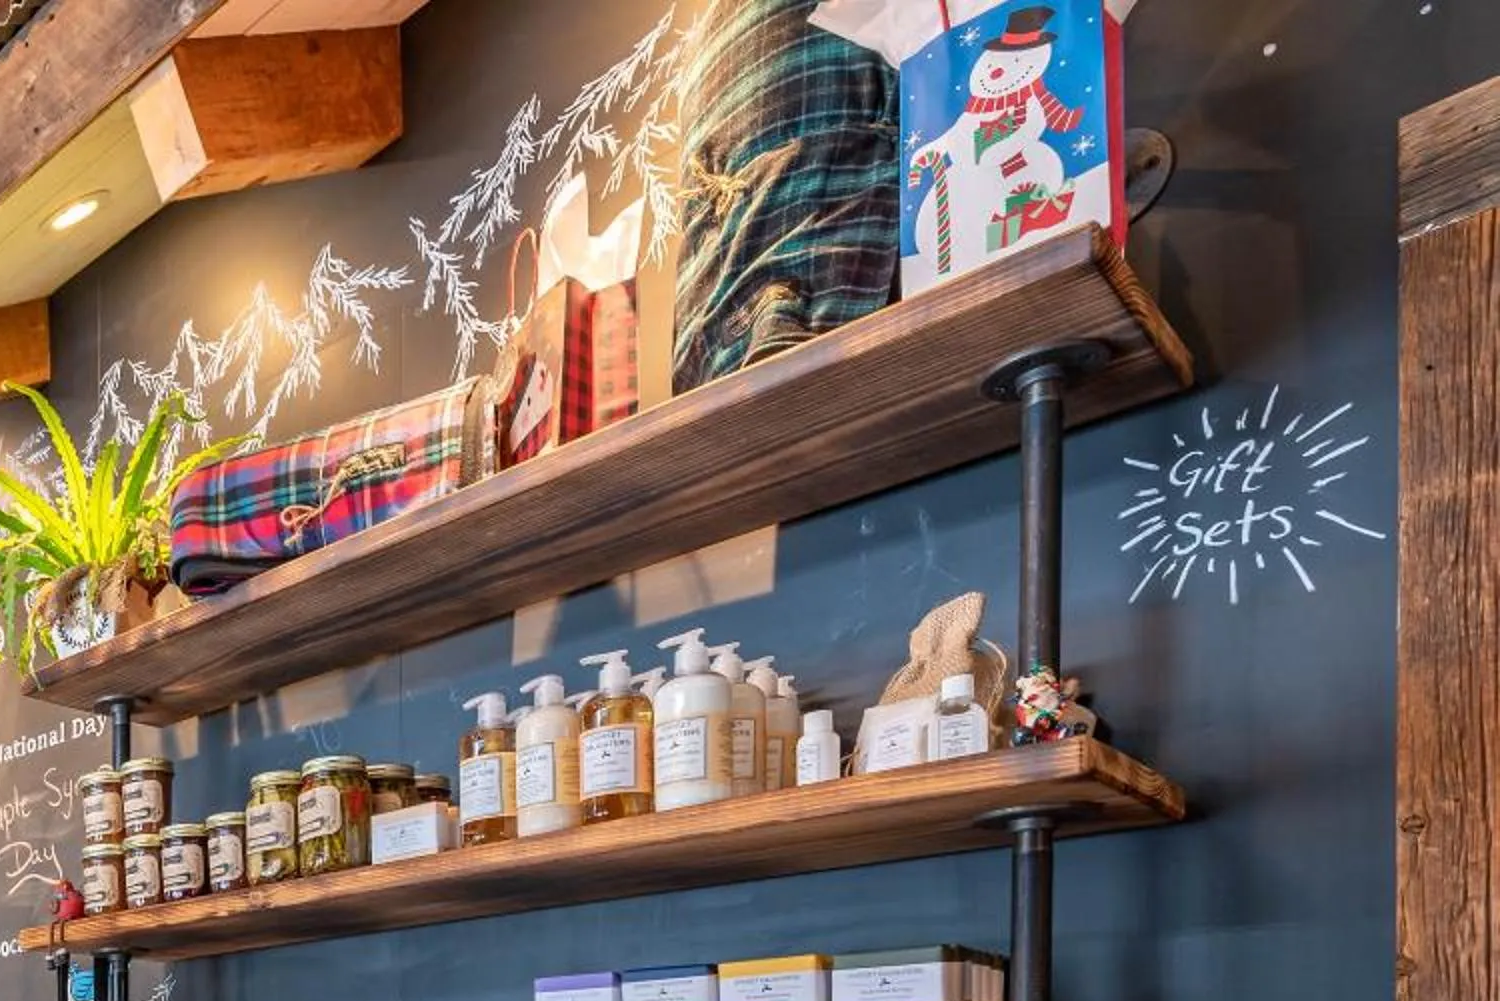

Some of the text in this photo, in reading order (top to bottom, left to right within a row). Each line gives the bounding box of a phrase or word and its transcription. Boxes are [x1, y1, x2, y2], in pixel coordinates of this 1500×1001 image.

[1168, 438, 1275, 499] Gift
[1172, 499, 1295, 556] Sets
[71, 714, 107, 738] Day
[43, 767, 81, 820] Sy
